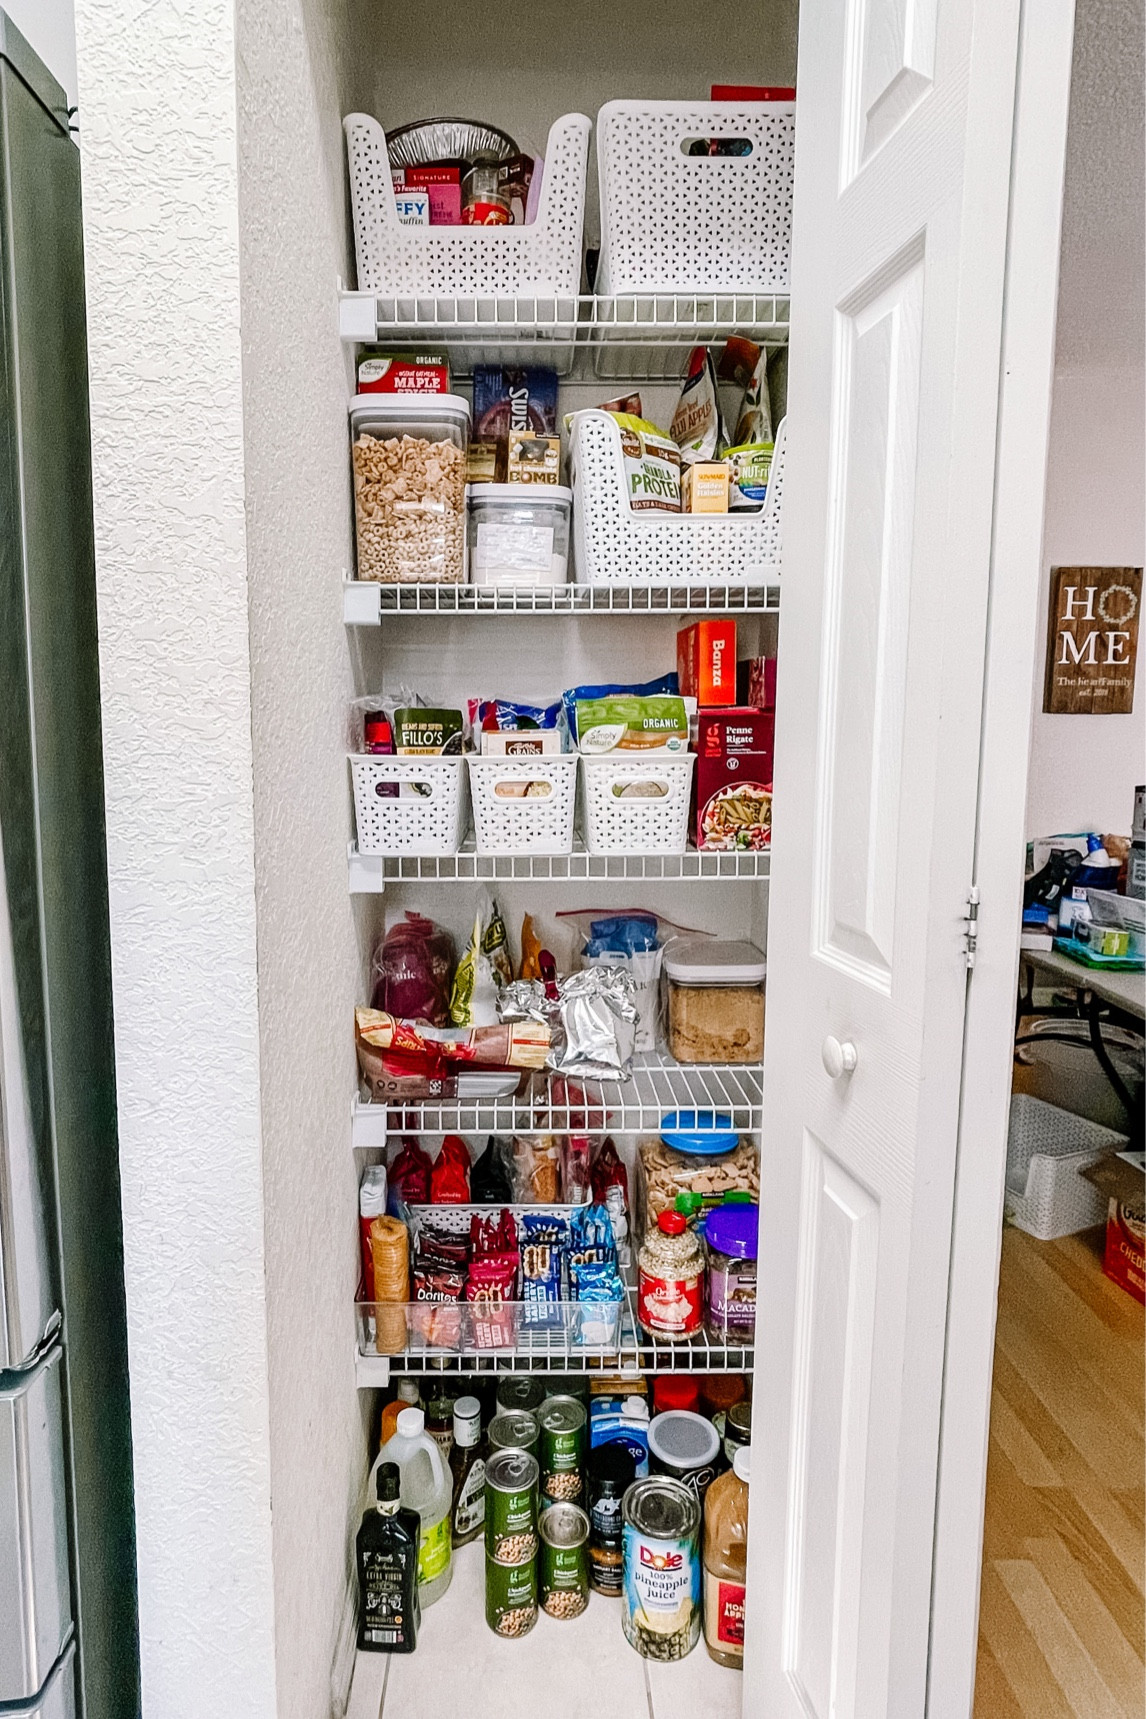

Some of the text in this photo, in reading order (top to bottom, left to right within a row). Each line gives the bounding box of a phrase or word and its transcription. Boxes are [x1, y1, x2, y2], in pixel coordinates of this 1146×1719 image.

[415, 356, 442, 365] ORGANIC
[394, 377, 441, 389] MAPLE
[509, 472, 558, 484] BOMB
[698, 482, 723, 491] Golden
[712, 639, 725, 687] Banza
[642, 718, 680, 729] ORGANIC
[590, 730, 617, 741] Simply
[726, 726, 753, 735] Penne
[402, 731, 443, 745] FILLO'S
[726, 735, 754, 745] Rigate
[417, 1288, 457, 1304] Doritos
[640, 1545, 683, 1568] Dole
[634, 1571, 689, 1591] pineapple
[650, 1571, 674, 1580] 100%
[647, 1586, 676, 1599] juice
